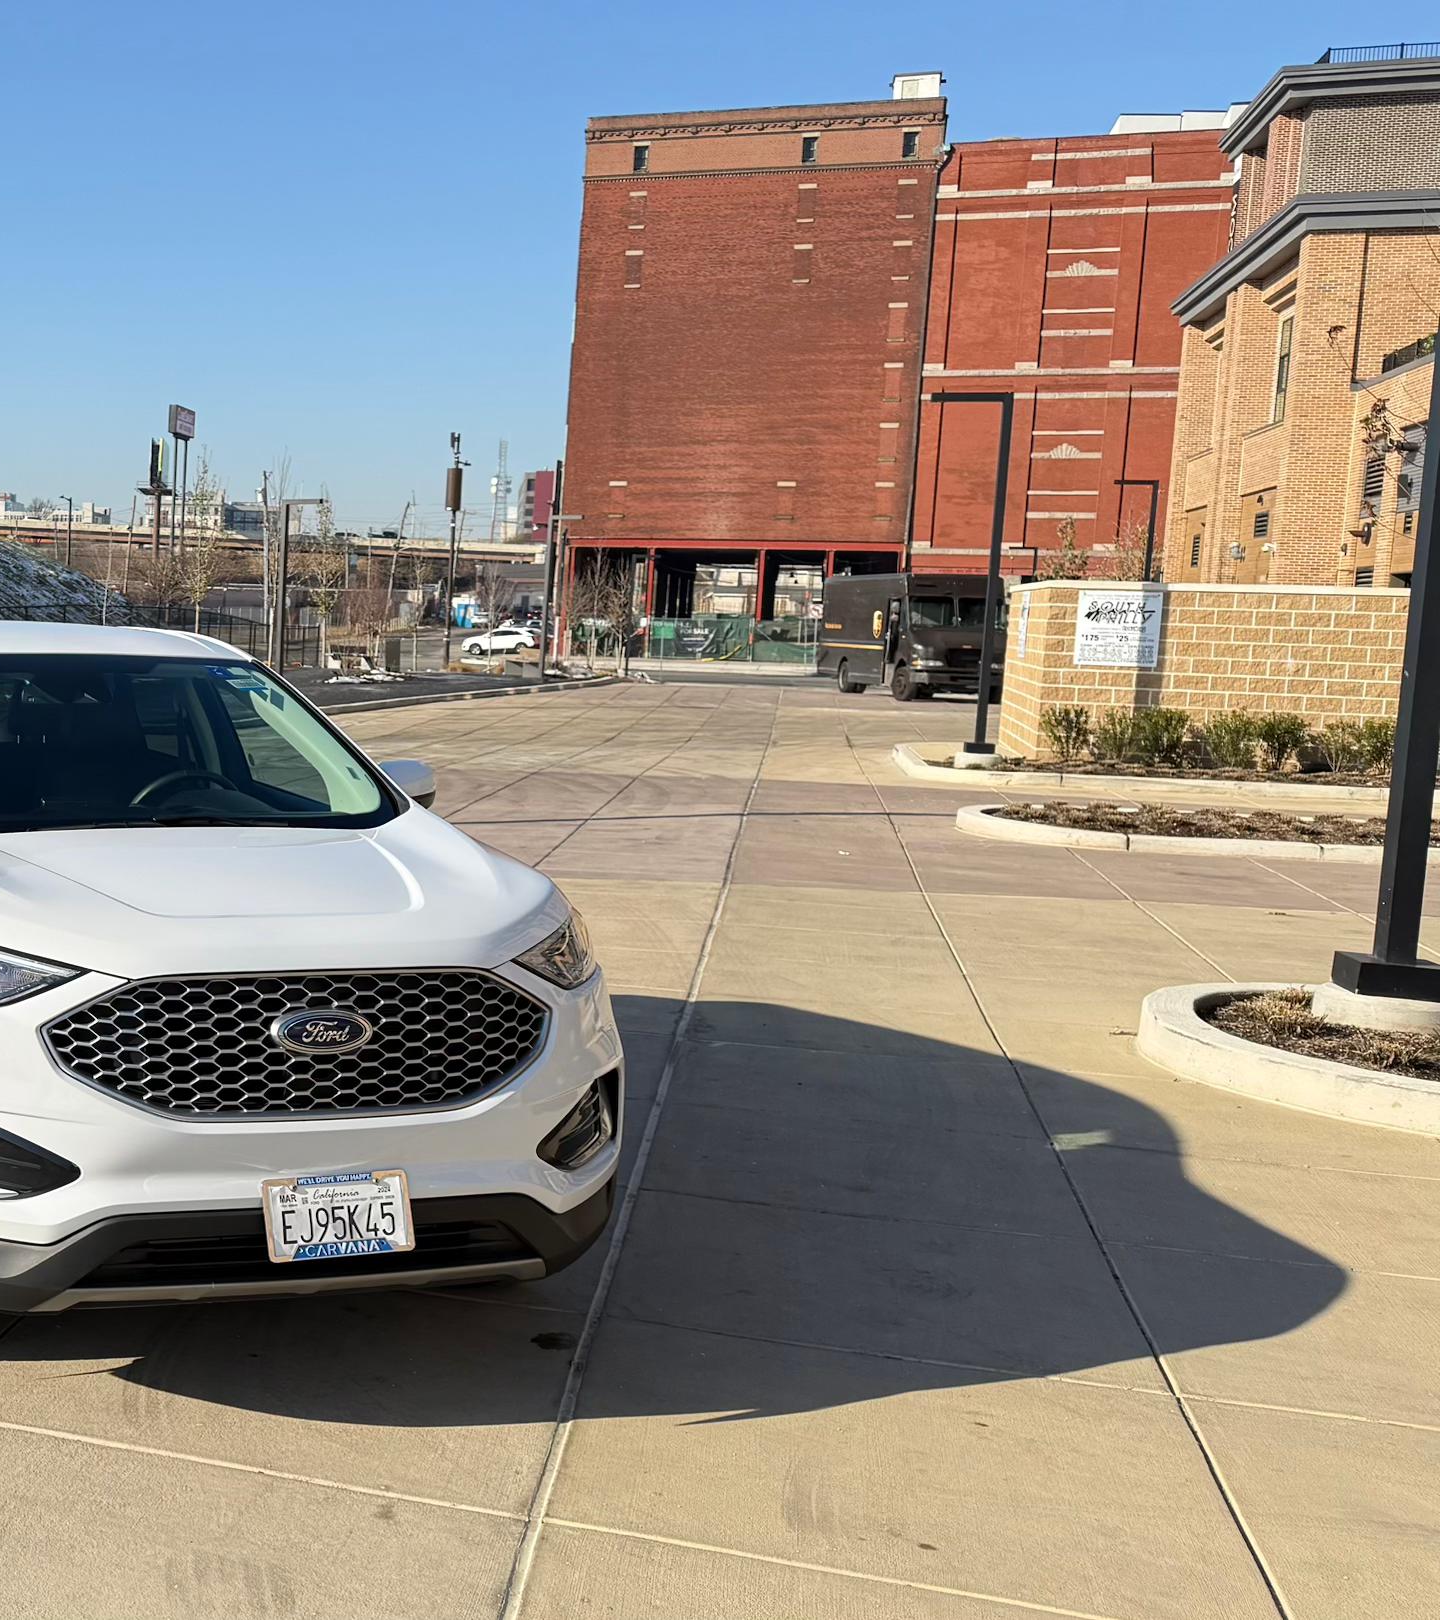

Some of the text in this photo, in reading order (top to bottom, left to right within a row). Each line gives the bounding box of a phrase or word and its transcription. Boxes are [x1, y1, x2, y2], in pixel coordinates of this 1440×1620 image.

[301, 1020, 351, 1043] Ford
[279, 1194, 297, 1204] MAR
[313, 1188, 360, 1203] California
[281, 1202, 396, 1245] EJ95K45
[305, 1239, 380, 1257] CARVANA
